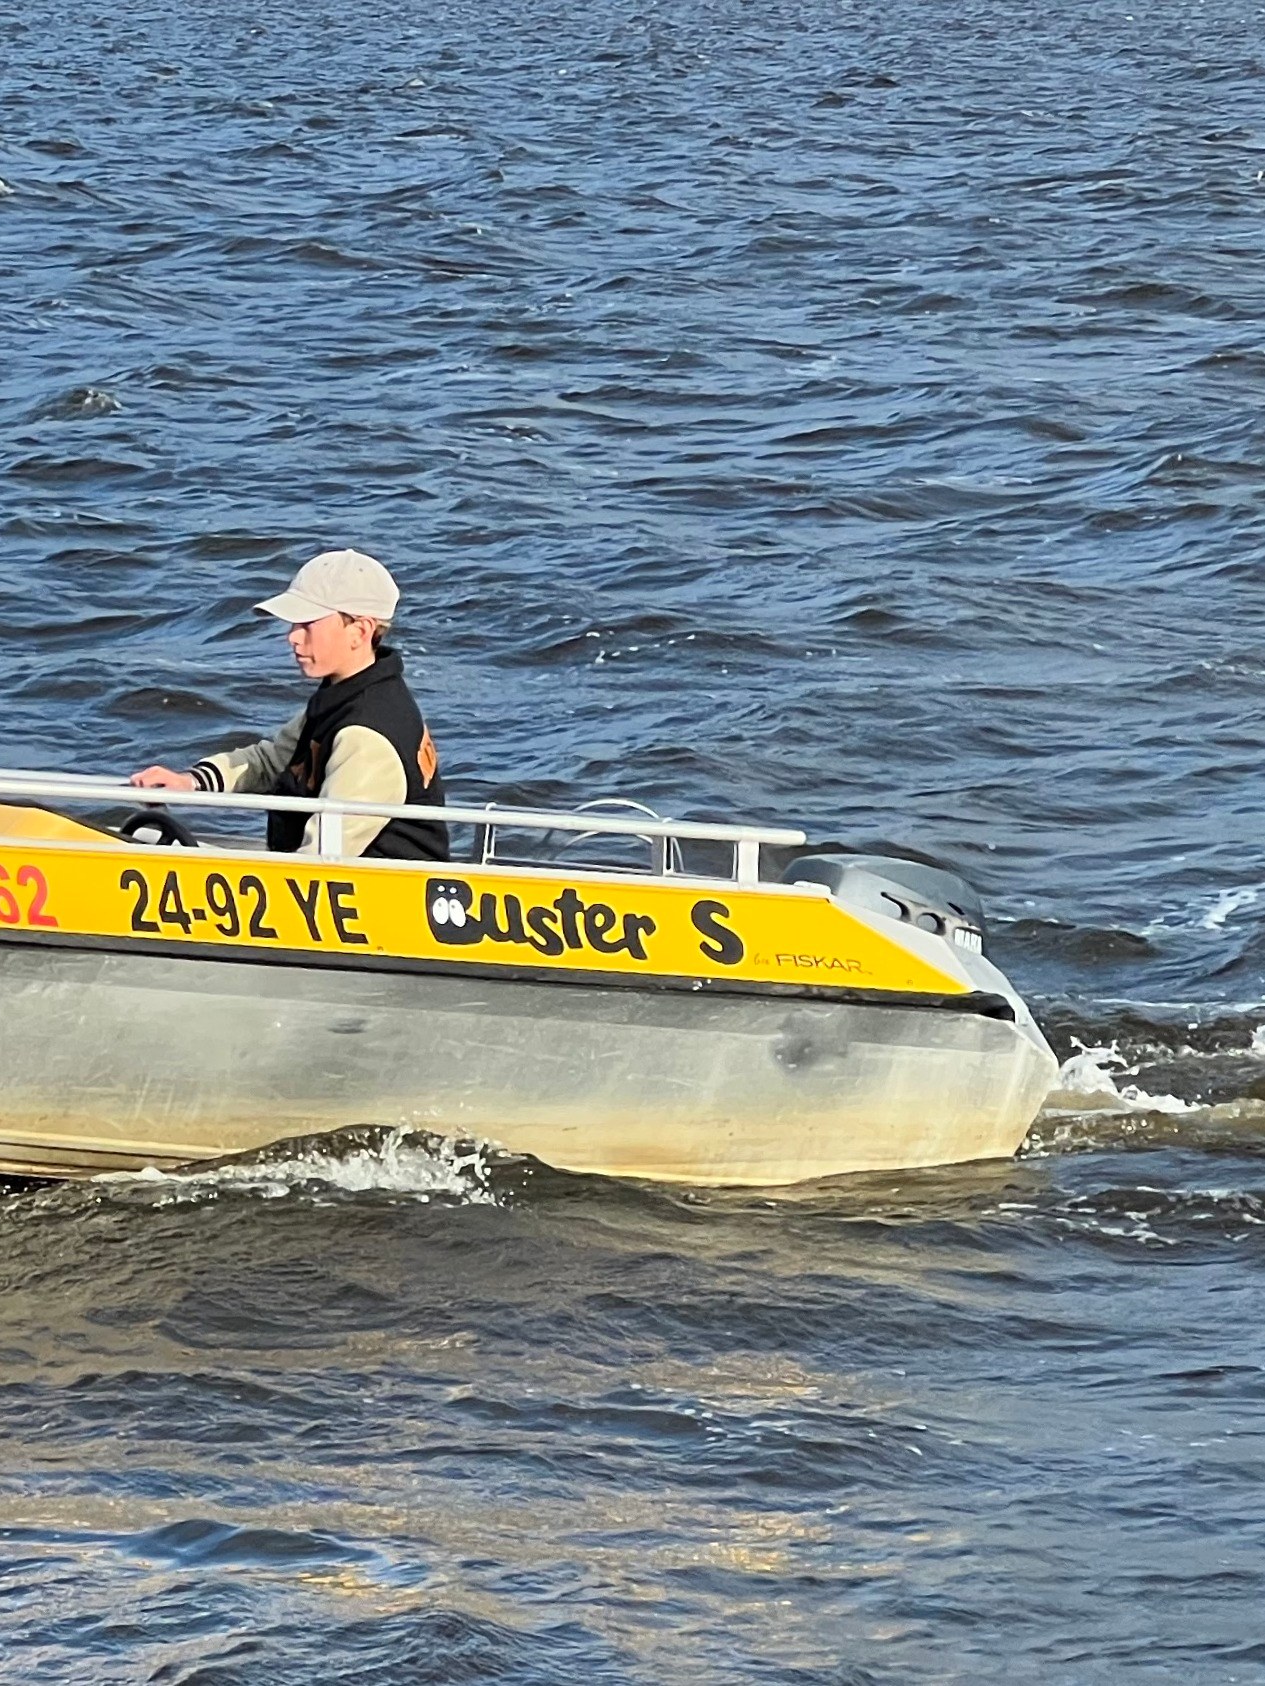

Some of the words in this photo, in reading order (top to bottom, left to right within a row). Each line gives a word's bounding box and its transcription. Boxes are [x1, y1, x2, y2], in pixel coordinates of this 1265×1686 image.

[120, 869, 277, 938] 24-92
[284, 878, 368, 945] YE
[426, 878, 656, 960] Buster
[690, 899, 745, 965] S
[775, 953, 873, 975] FISKAR
